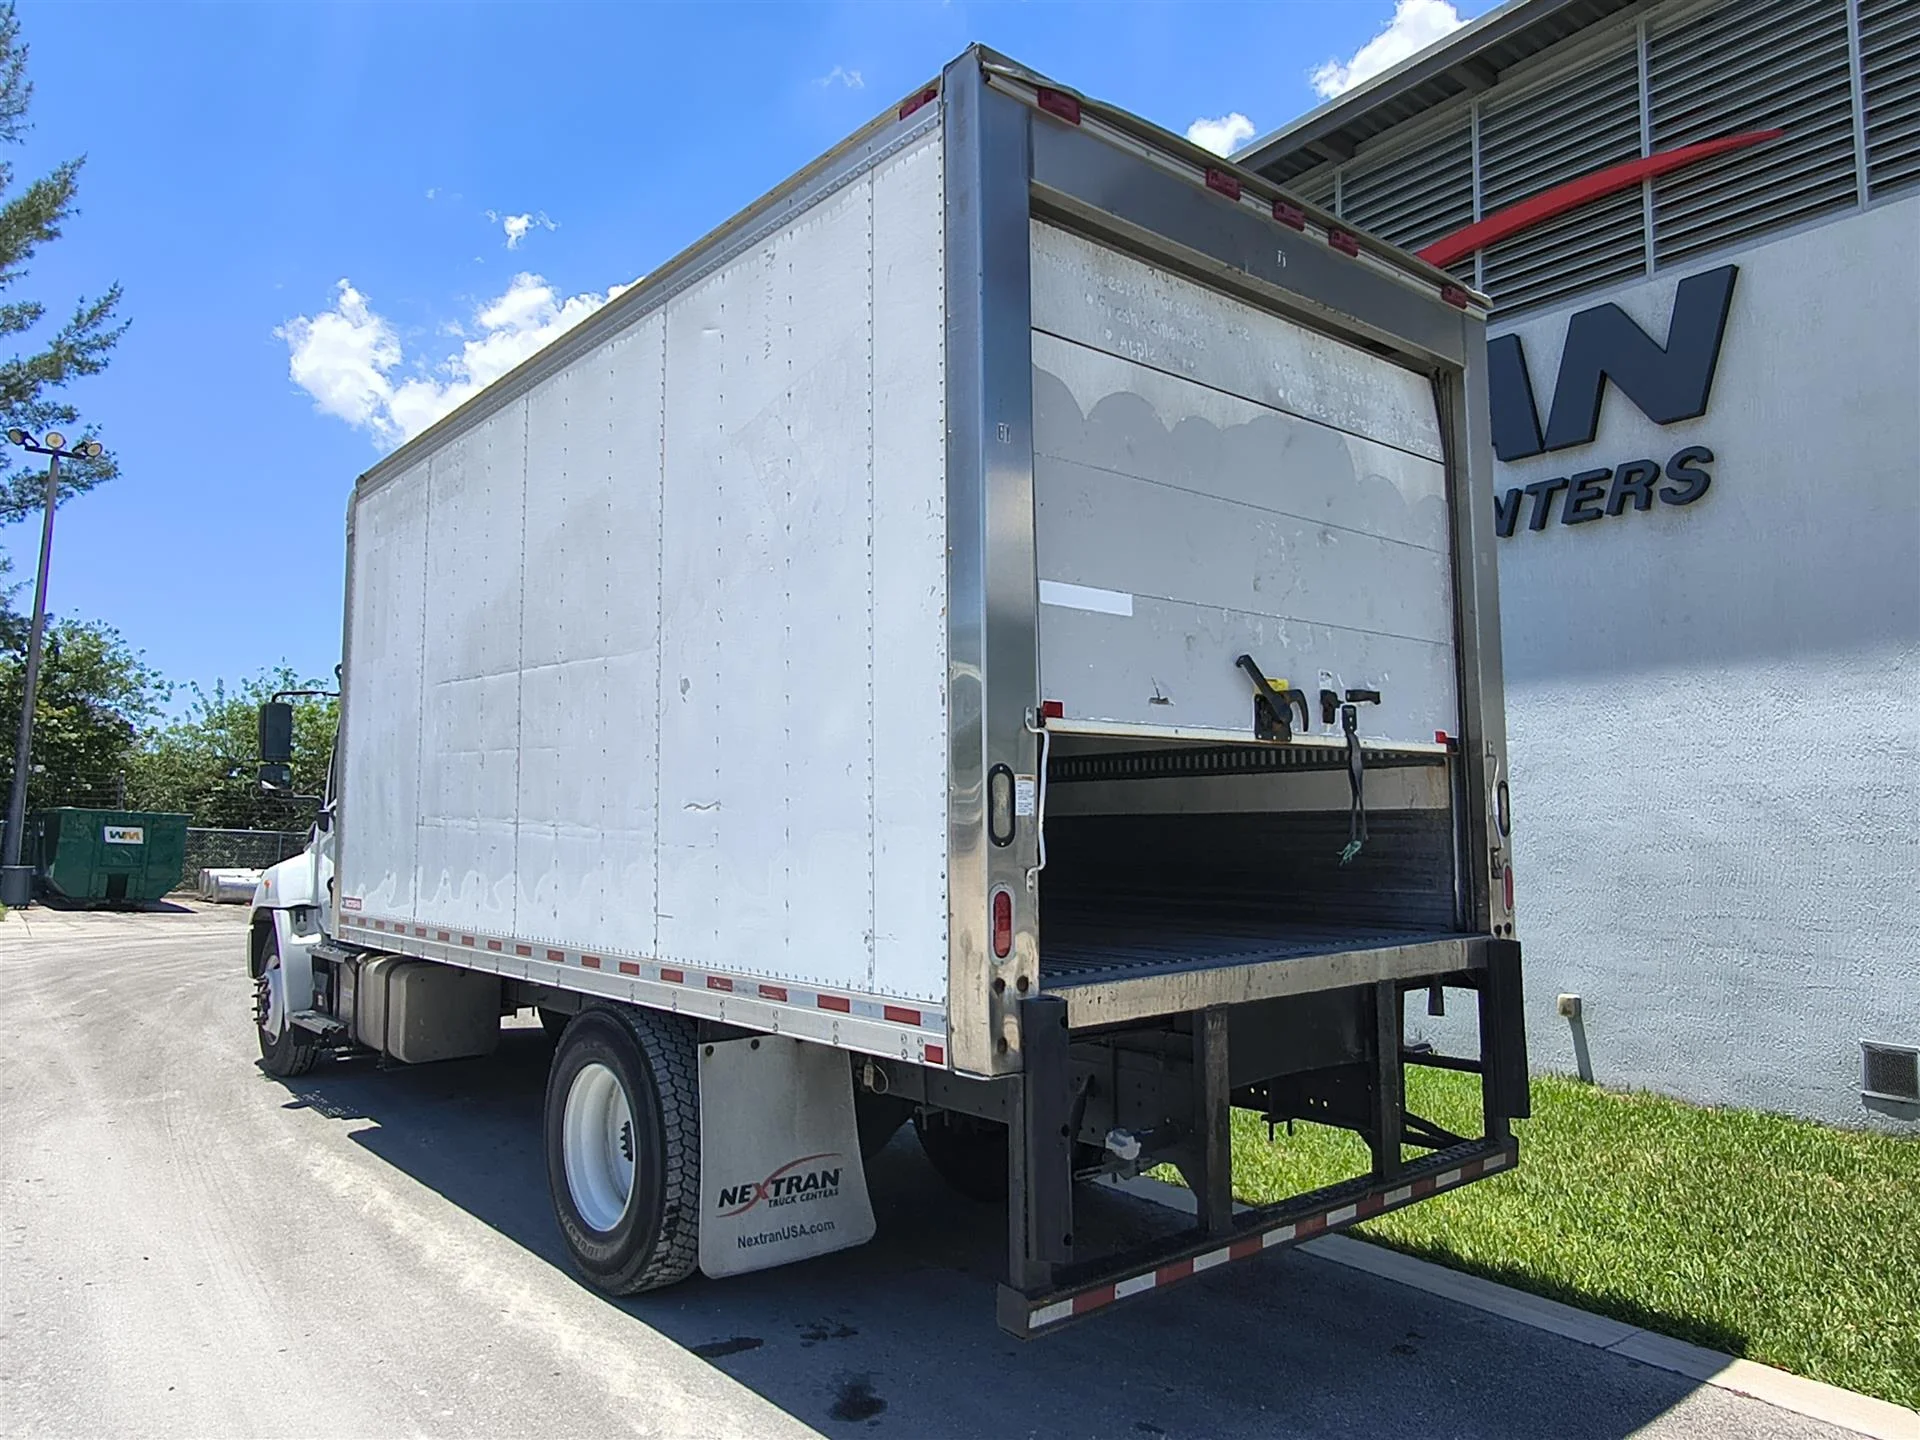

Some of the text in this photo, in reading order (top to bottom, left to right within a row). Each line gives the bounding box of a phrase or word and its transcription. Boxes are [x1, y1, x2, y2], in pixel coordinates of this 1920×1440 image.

[109, 830, 140, 840] WM
[717, 1168, 840, 1208] NEXTRAN
[768, 1187, 839, 1209] TRUCK CENTERS
[737, 1220, 836, 1249] NextranUSA.com
